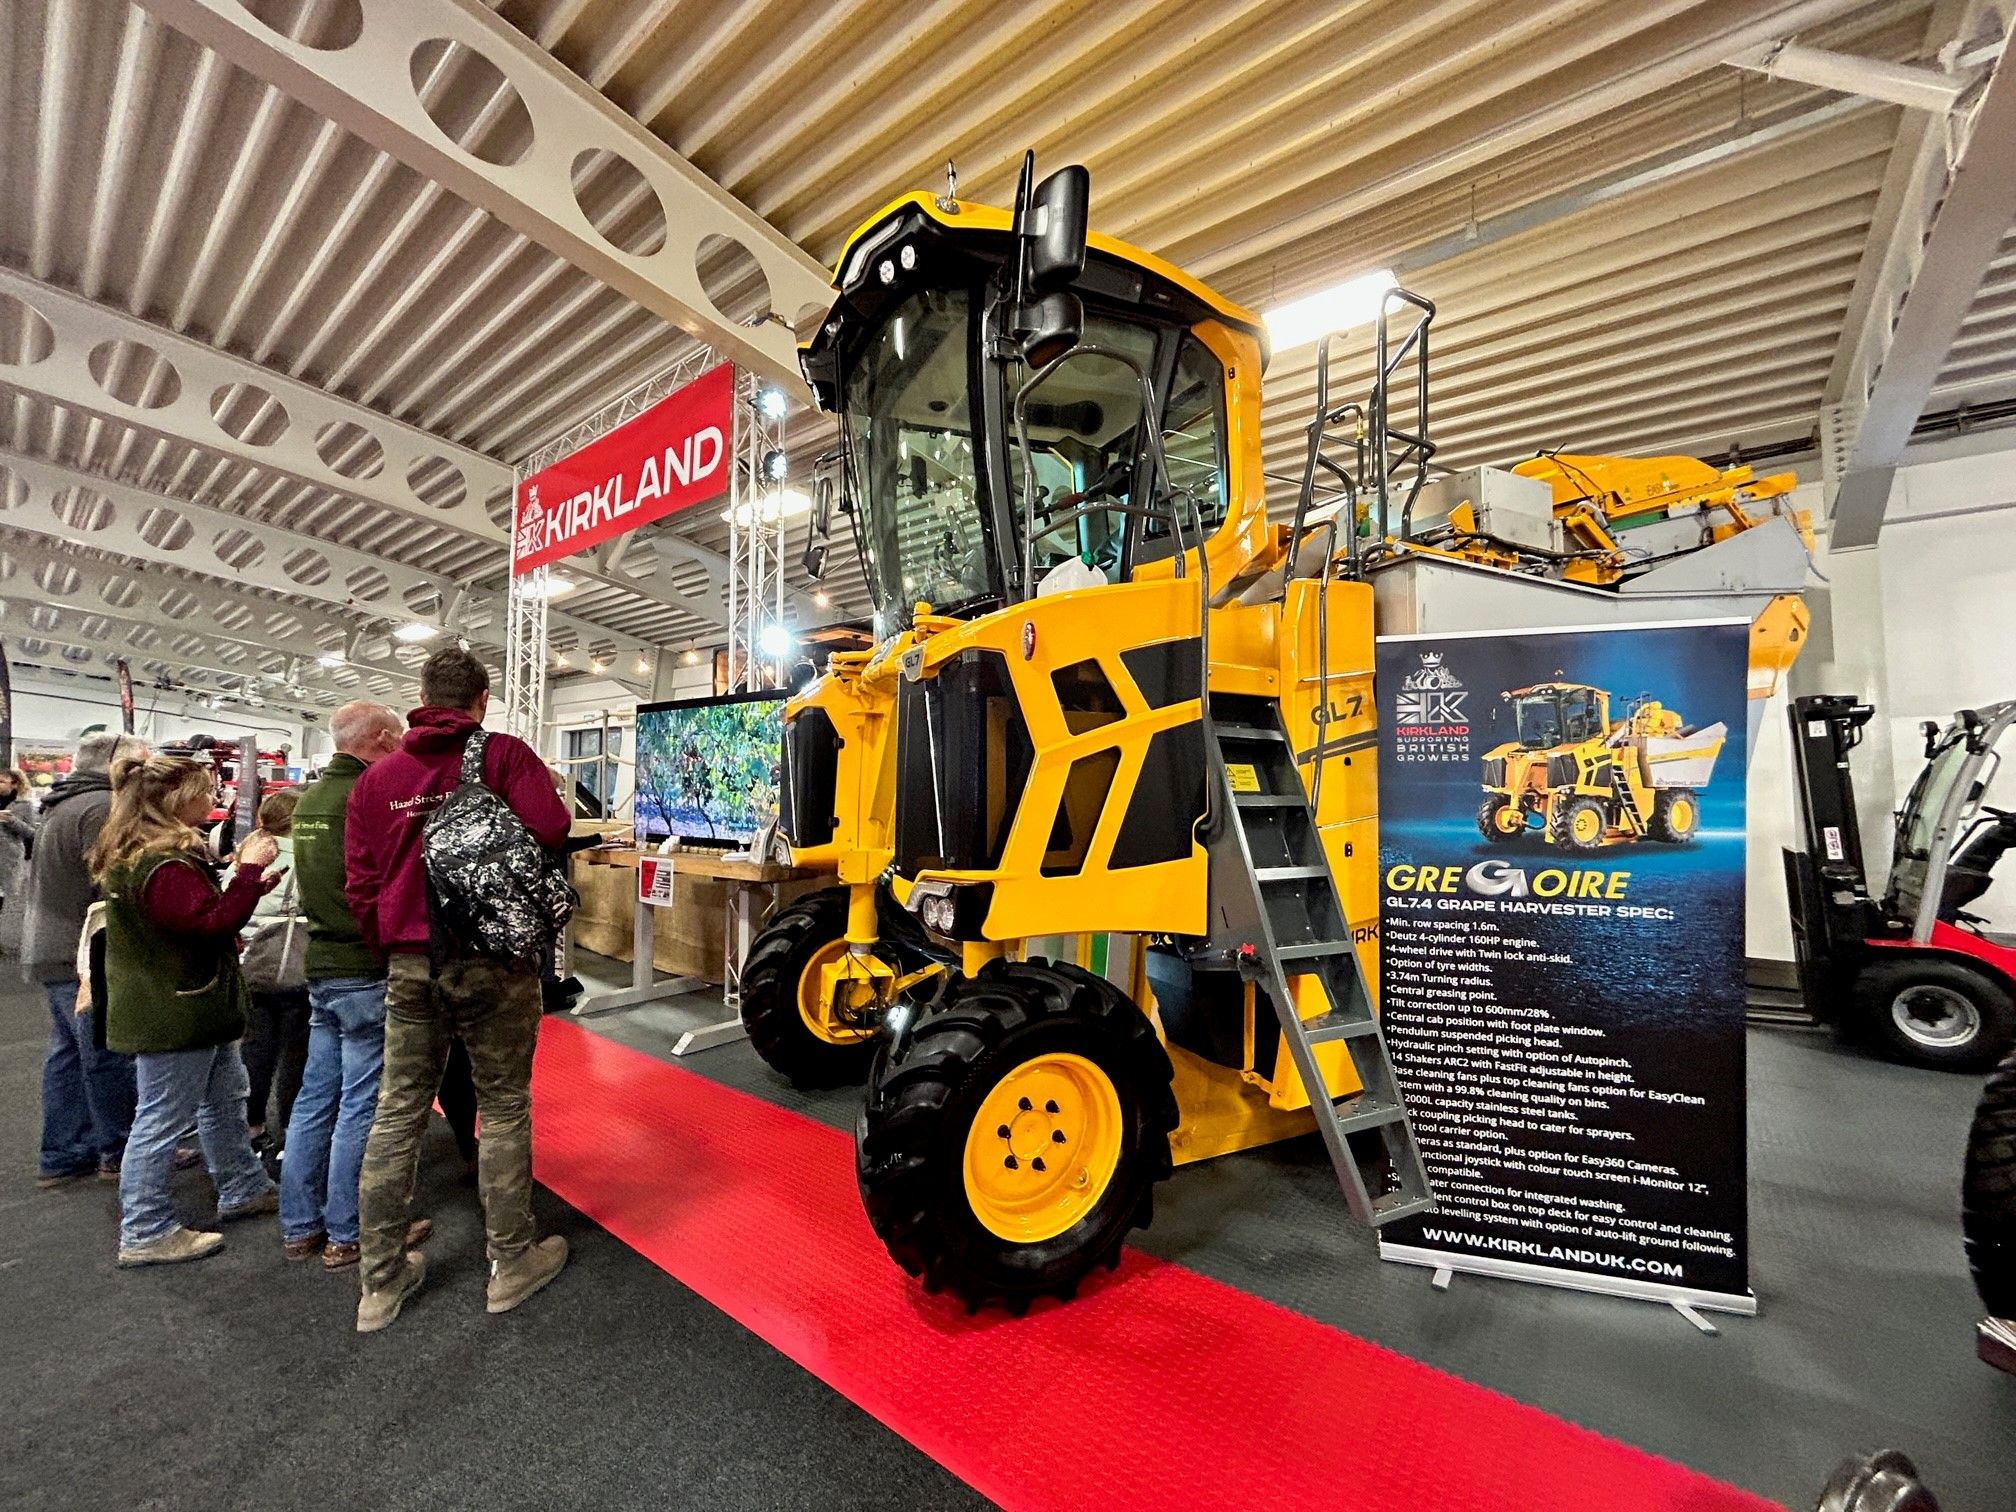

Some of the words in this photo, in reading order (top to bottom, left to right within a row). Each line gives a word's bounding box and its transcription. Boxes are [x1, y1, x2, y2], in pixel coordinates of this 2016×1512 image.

[544, 426, 723, 548] KIRKLAND
[1396, 726, 1470, 737] KIRKLAND
[1396, 753, 1470, 762] GROWERS
[1397, 744, 1470, 753] BRITISH
[1386, 897, 1432, 911] GL7.4
[1437, 898, 1496, 913] GRAPE
[1500, 901, 1611, 918] HARVESTER
[1617, 905, 1674, 921] SPEC:
[1434, 921, 1470, 932] spacing
[1472, 922, 1499, 931] 1.6m.
[1419, 933, 1466, 944] 4-cylinder
[1470, 936, 1500, 944] 160HP
[1503, 938, 1540, 948] engine.
[1425, 960, 1435, 968] of
[1437, 962, 1456, 971] tyre
[1458, 963, 1492, 972] widths.
[1430, 947, 1453, 956] drive
[1456, 949, 1476, 957] with
[1478, 950, 1501, 959] Twin
[1504, 951, 1524, 960] lock
[1527, 953, 1573, 963] anti-skid.
[1422, 974, 1458, 986] Turning
[1461, 977, 1493, 986] radius.
[1426, 989, 1466, 1000] greasing
[1469, 991, 1497, 1000] point.
[1407, 1002, 1455, 1011] correction
[1458, 1005, 1470, 1014] up
[1473, 1005, 1483, 1013] to
[1427, 1016, 1443, 1024] cab
[1446, 1017, 1484, 1026] position
[1487, 1020, 1508, 1028] with
[1511, 1021, 1531, 1031] foot
[1534, 1024, 1560, 1033] plate
[1562, 1026, 1606, 1036] window.
[1441, 1031, 1493, 1041] suspended
[1496, 1034, 1531, 1047] picking
[1534, 1037, 1562, 1048] head.
[1438, 1044, 1463, 1053] pinch
[1466, 1046, 1499, 1058] setting
[1501, 1049, 1523, 1058] with
[1526, 1052, 1558, 1061] option
[1562, 1054, 1572, 1062] of
[1574, 1055, 1632, 1068] Autopinch.
[1405, 1054, 1441, 1064] Shakers
[1444, 1057, 1468, 1066] ARC2
[1471, 1060, 1492, 1069] with
[1495, 1061, 1527, 1072] FastFit
[1530, 1065, 1583, 1078] adjustable
[1586, 1070, 1595, 1078] in
[1598, 1070, 1634, 1083] height.
[1416, 1068, 1455, 1081] cleaning
[1457, 1071, 1478, 1081] fans
[1480, 1074, 1500, 1084] plus
[1503, 1077, 1520, 1087] top
[1522, 1078, 1566, 1093] cleaning
[1568, 1082, 1590, 1092] fans
[1592, 1086, 1626, 1096] option
[1629, 1088, 1646, 1098] for
[1649, 1090, 1705, 1104] EasyClean
[1424, 1083, 1444, 1092] with
[1455, 1085, 1484, 1096] 99.8%
[1487, 1088, 1529, 1102] cleaning
[1531, 1095, 1566, 1106] quality
[1568, 1098, 1582, 1106] on
[1585, 1098, 1609, 1108] bins.
[1405, 1094, 1432, 1104] 2000L
[1435, 1099, 1474, 1110] capacity
[1476, 1102, 1518, 1113] stainless
[1521, 1107, 1545, 1116] steel
[1548, 1110, 1578, 1120] tanks.
[1419, 1124, 1436, 1132] tool
[1440, 1126, 1471, 1135] carrier
[1473, 1130, 1508, 1140] option.
[1420, 1111, 1460, 1123] coupling
[1463, 1114, 1497, 1127] picking
[1500, 1117, 1524, 1128] head
[1527, 1122, 1538, 1130] to
[1540, 1124, 1566, 1132] cater
[1569, 1125, 1584, 1134] for
[1586, 1129, 1634, 1140] sprayers.
[1456, 1142, 1502, 1154] standard,
[1504, 1146, 1526, 1156] plus
[1528, 1150, 1561, 1160] option
[1564, 1153, 1579, 1162] for
[1582, 1155, 1624, 1168] Easy360
[1627, 1160, 1678, 1175] Cameras.
[1426, 1166, 1483, 1178] compatible.
[1464, 1155, 1501, 1166] joystick
[1504, 1160, 1525, 1170] with
[1528, 1164, 1560, 1174] colour
[1563, 1168, 1592, 1178] touch
[1595, 1172, 1630, 1183] screen
[1633, 1175, 1684, 1190] i-Monitor
[1451, 1182, 1504, 1195] connection
[1508, 1188, 1522, 1197] for
[1524, 1190, 1577, 1205] integrated
[1579, 1199, 1625, 1213] washing.
[1454, 1196, 1488, 1206] control
[1492, 1199, 1510, 1210] box
[1512, 1204, 1526, 1212] on
[1528, 1206, 1545, 1216] top
[1548, 1208, 1572, 1218] deck
[1575, 1211, 1590, 1220] for
[1592, 1215, 1616, 1226] easy
[1618, 1219, 1657, 1230] control
[1660, 1224, 1681, 1234] and
[1684, 1227, 1733, 1242] cleaning.
[1442, 1206, 1481, 1221] levelling
[1484, 1214, 1518, 1225] system
[1521, 1219, 1542, 1228] with
[1546, 1223, 1578, 1233] option
[1582, 1227, 1592, 1235] of
[1595, 1230, 1636, 1242] auto-lift
[1639, 1236, 1679, 1248] ground
[1682, 1240, 1735, 1257] following.
[1422, 1227, 1683, 1278] WWW.KIRKLANDUK.COM
